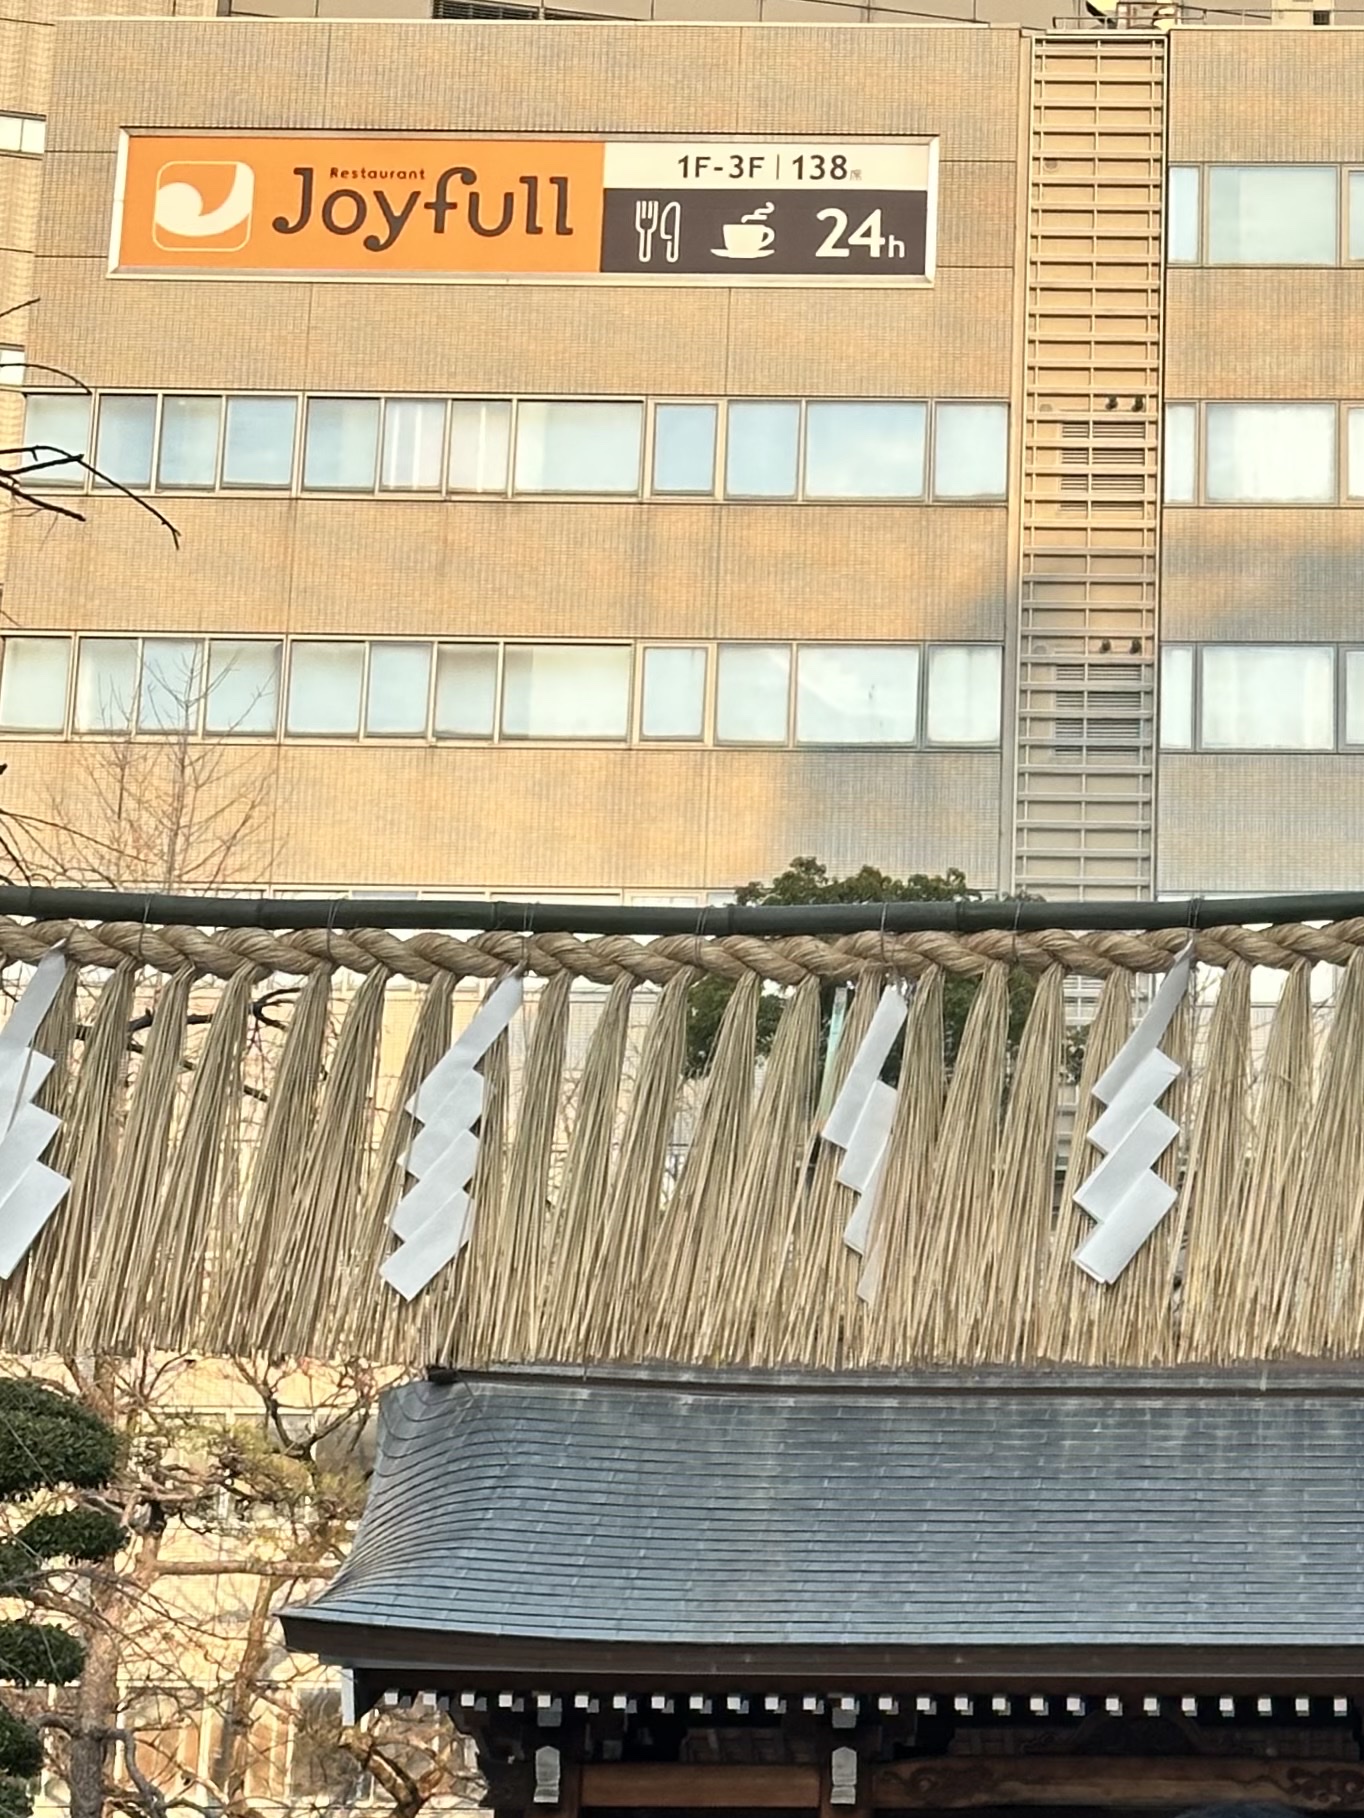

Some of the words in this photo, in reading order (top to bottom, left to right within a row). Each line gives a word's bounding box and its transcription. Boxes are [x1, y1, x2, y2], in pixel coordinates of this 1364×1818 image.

[329, 167, 426, 180] Restaurant
[678, 155, 766, 179] 1F-3F
[272, 166, 574, 252] Joyfull
[815, 207, 905, 258] 24h
